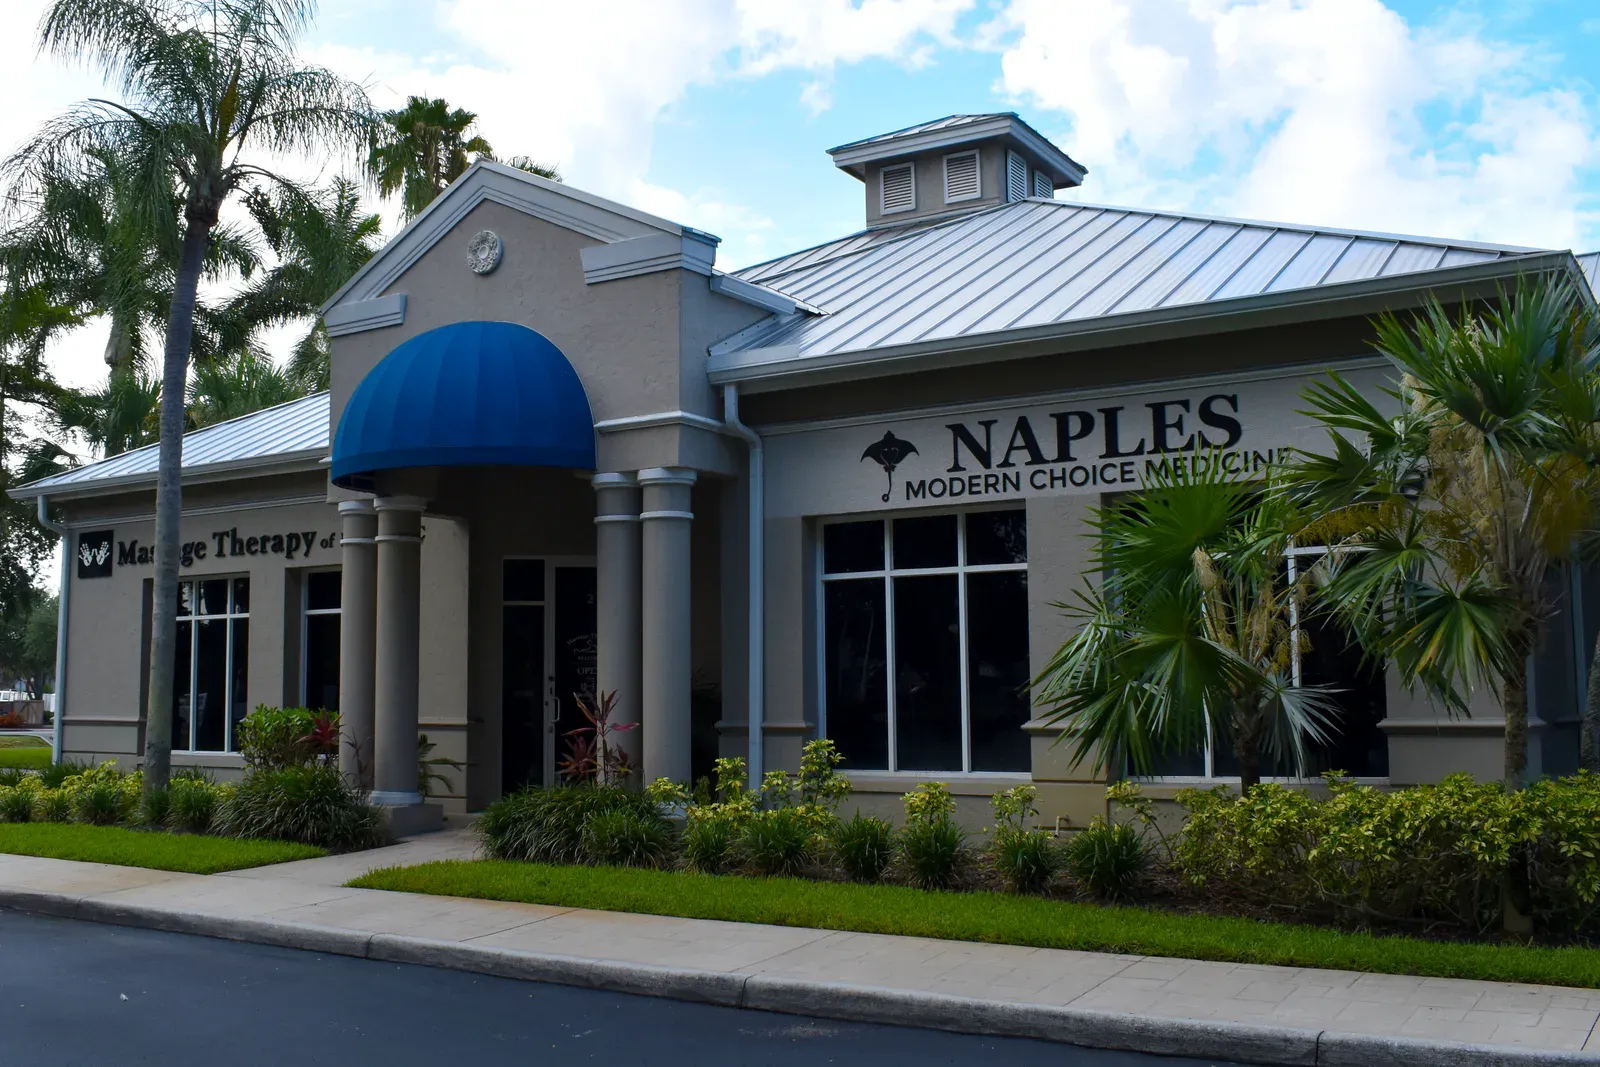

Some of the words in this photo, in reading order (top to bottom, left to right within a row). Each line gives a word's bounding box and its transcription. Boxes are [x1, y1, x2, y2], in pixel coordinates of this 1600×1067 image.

[945, 394, 1243, 473] NAPLES
[905, 471, 1021, 501] MODERN
[1029, 461, 1136, 491] CHOICE
[117, 540, 207, 567] Masge
[212, 527, 317, 559] Therapy
[319, 532, 336, 549] of
